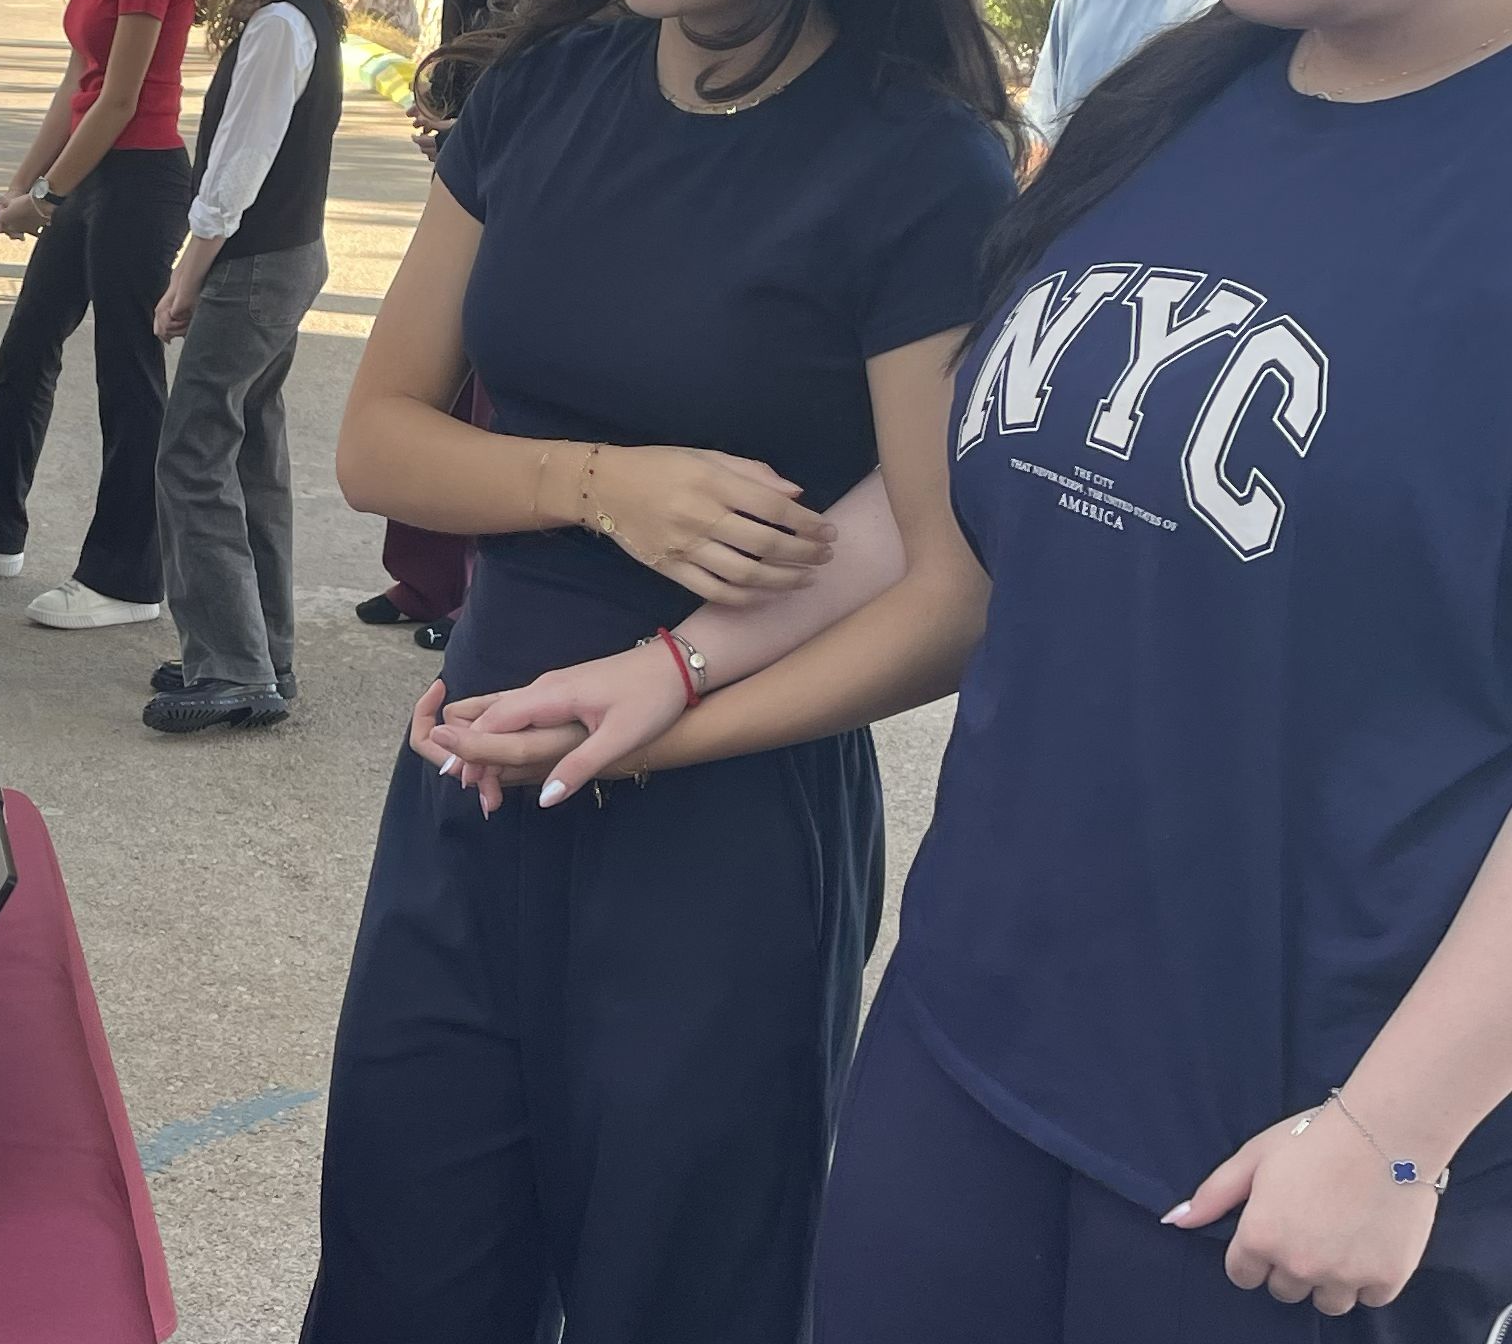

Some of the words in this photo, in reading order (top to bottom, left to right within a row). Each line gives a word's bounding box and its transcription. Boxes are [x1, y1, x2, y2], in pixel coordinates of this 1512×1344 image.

[956, 262, 1329, 562] NYC
[1009, 458, 1033, 473] THAT
[1032, 465, 1059, 483] NEVER
[1087, 486, 1104, 501] THE
[1103, 493, 1134, 513] UNITED
[1133, 506, 1163, 527] STATES
[1162, 519, 1179, 532] OF
[1074, 465, 1092, 481] THE
[1093, 474, 1115, 490] CITY
[1058, 492, 1124, 531] AMERICA
